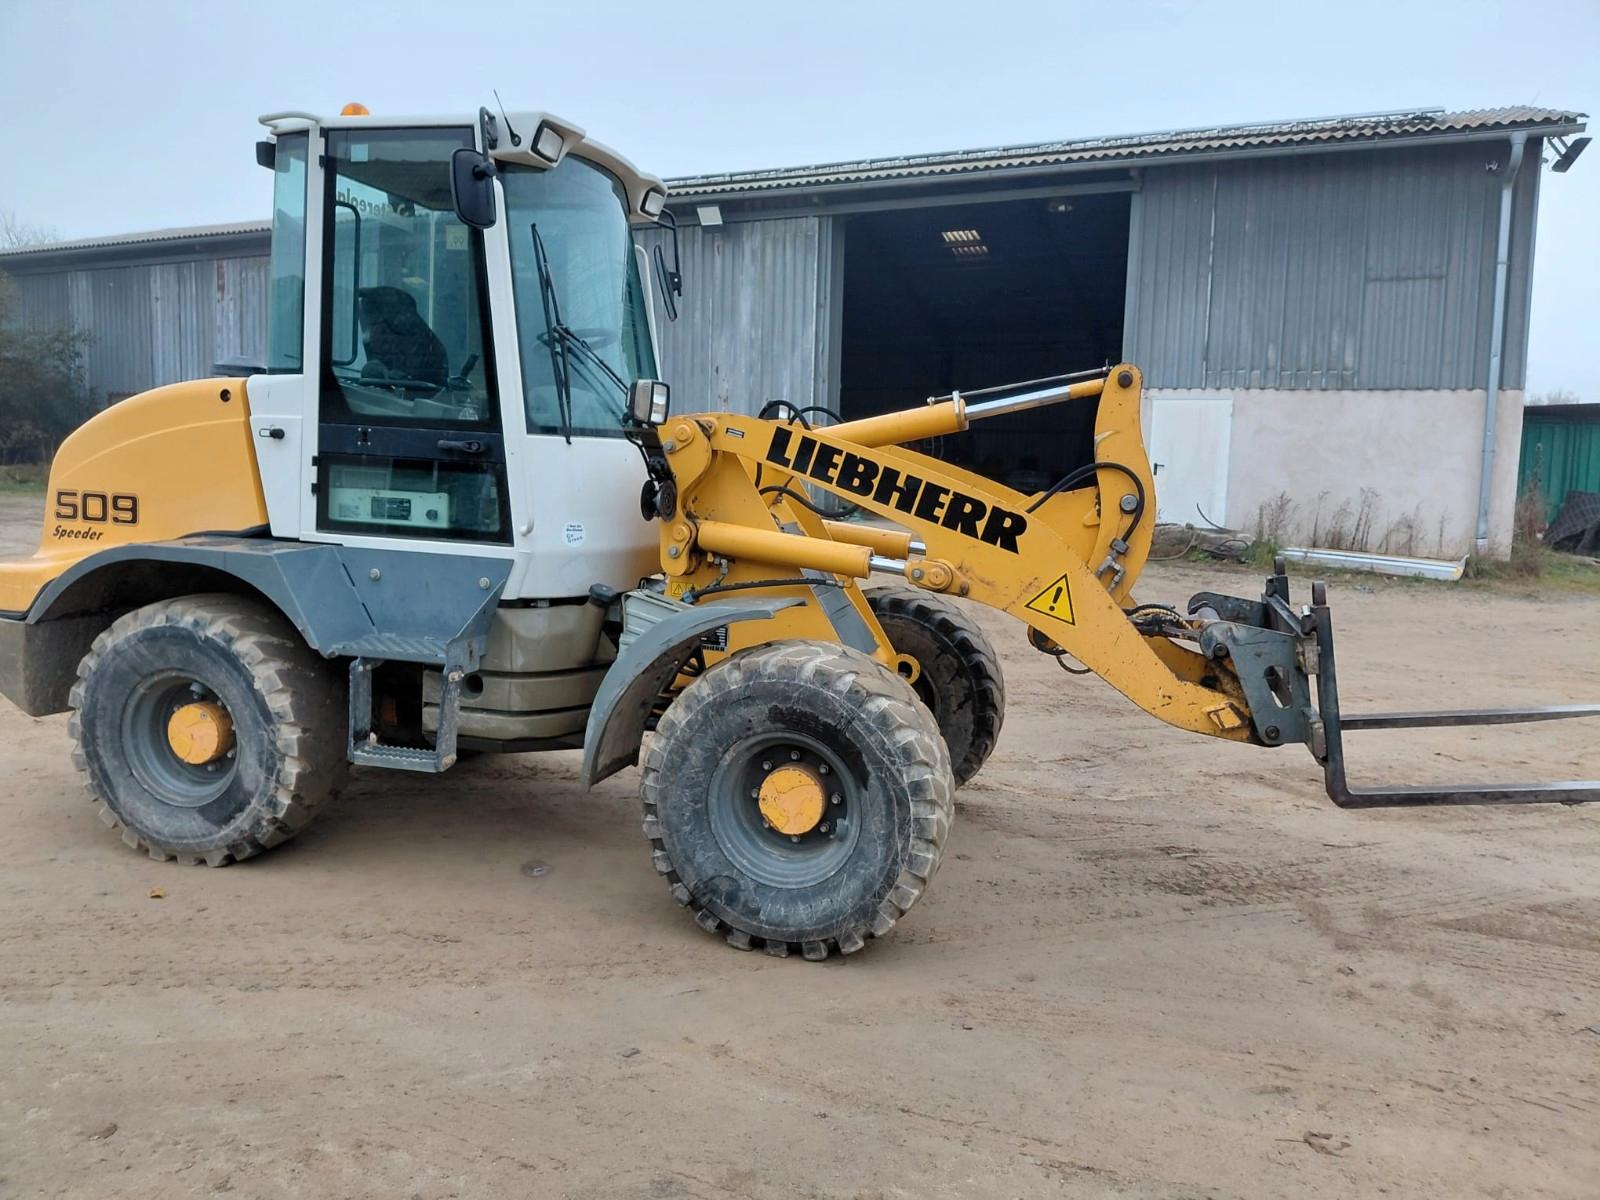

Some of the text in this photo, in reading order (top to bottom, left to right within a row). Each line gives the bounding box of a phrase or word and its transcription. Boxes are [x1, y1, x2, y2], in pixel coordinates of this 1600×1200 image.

[55, 490, 139, 525] 509
[766, 426, 1027, 554] LIEBHERR
[53, 525, 104, 541] Speeder
